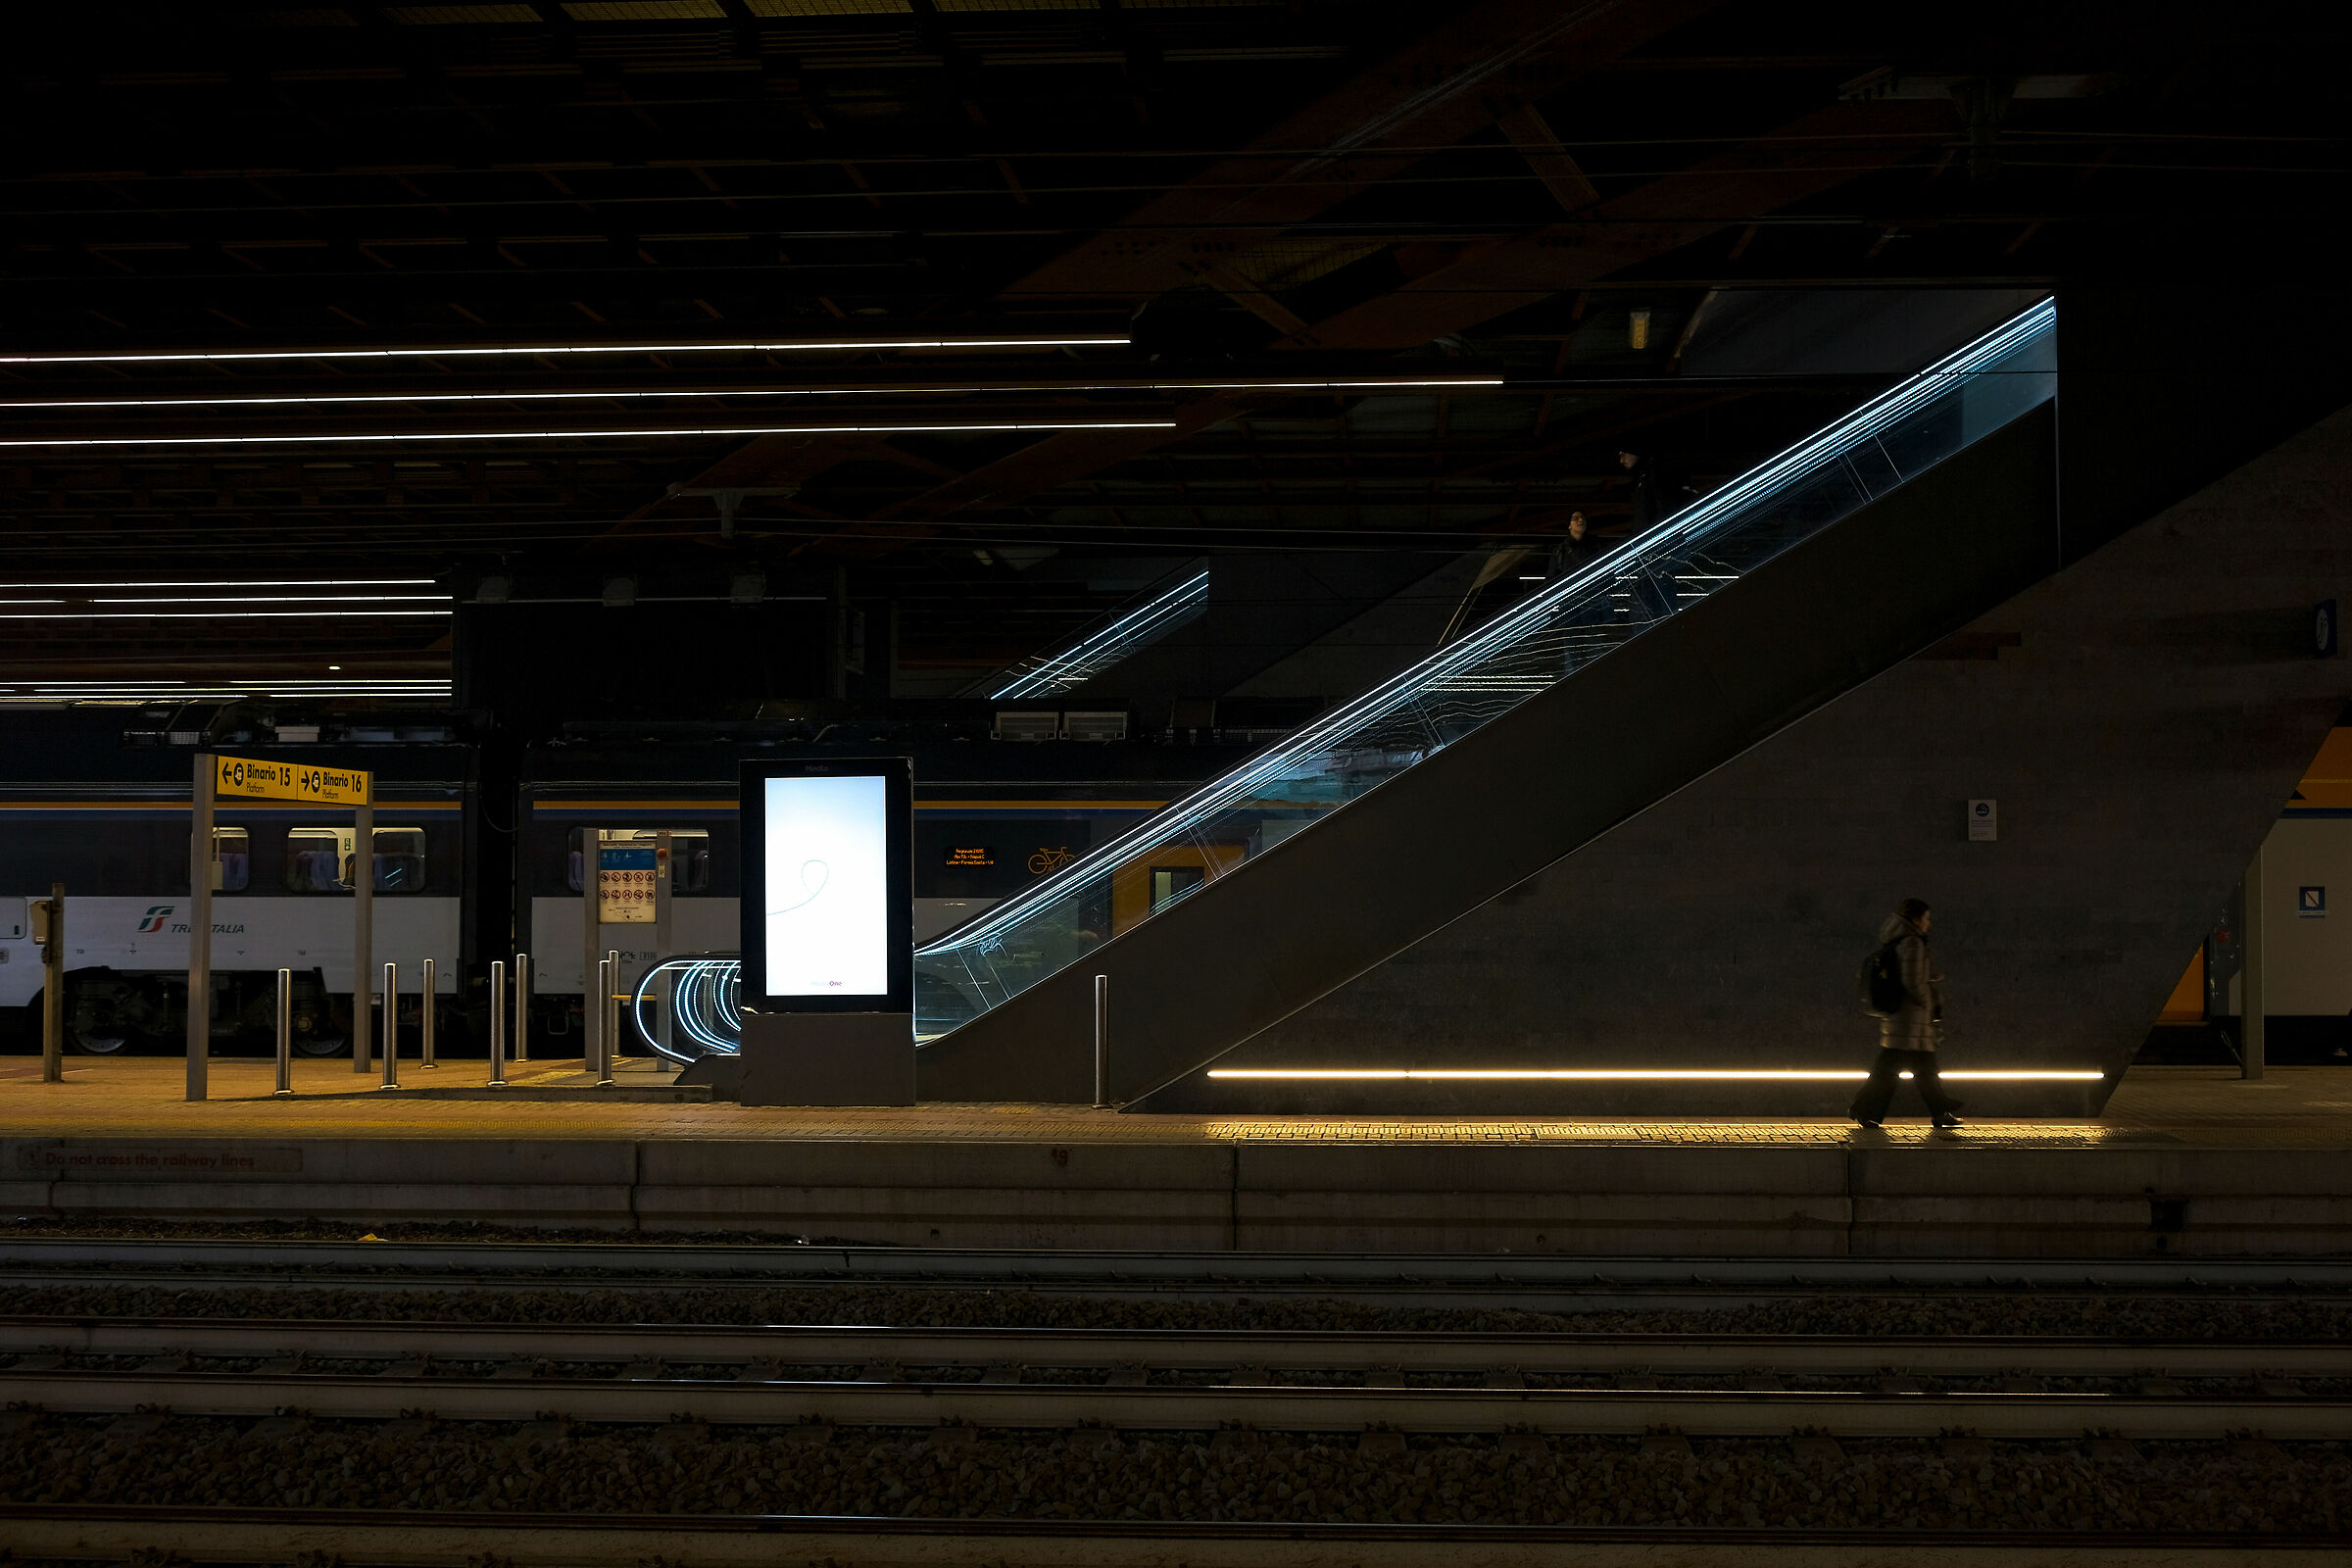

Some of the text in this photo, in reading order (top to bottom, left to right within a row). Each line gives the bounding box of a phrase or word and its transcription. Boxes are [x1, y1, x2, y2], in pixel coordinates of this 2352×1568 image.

[246, 763, 291, 787] Binario 15
[322, 771, 362, 793] Binario 16
[246, 782, 266, 794] Platform
[322, 789, 339, 800] Platform
[172, 924, 244, 934] TRTALIA
[46, 1152, 255, 1169] Do not cross the railway lines
